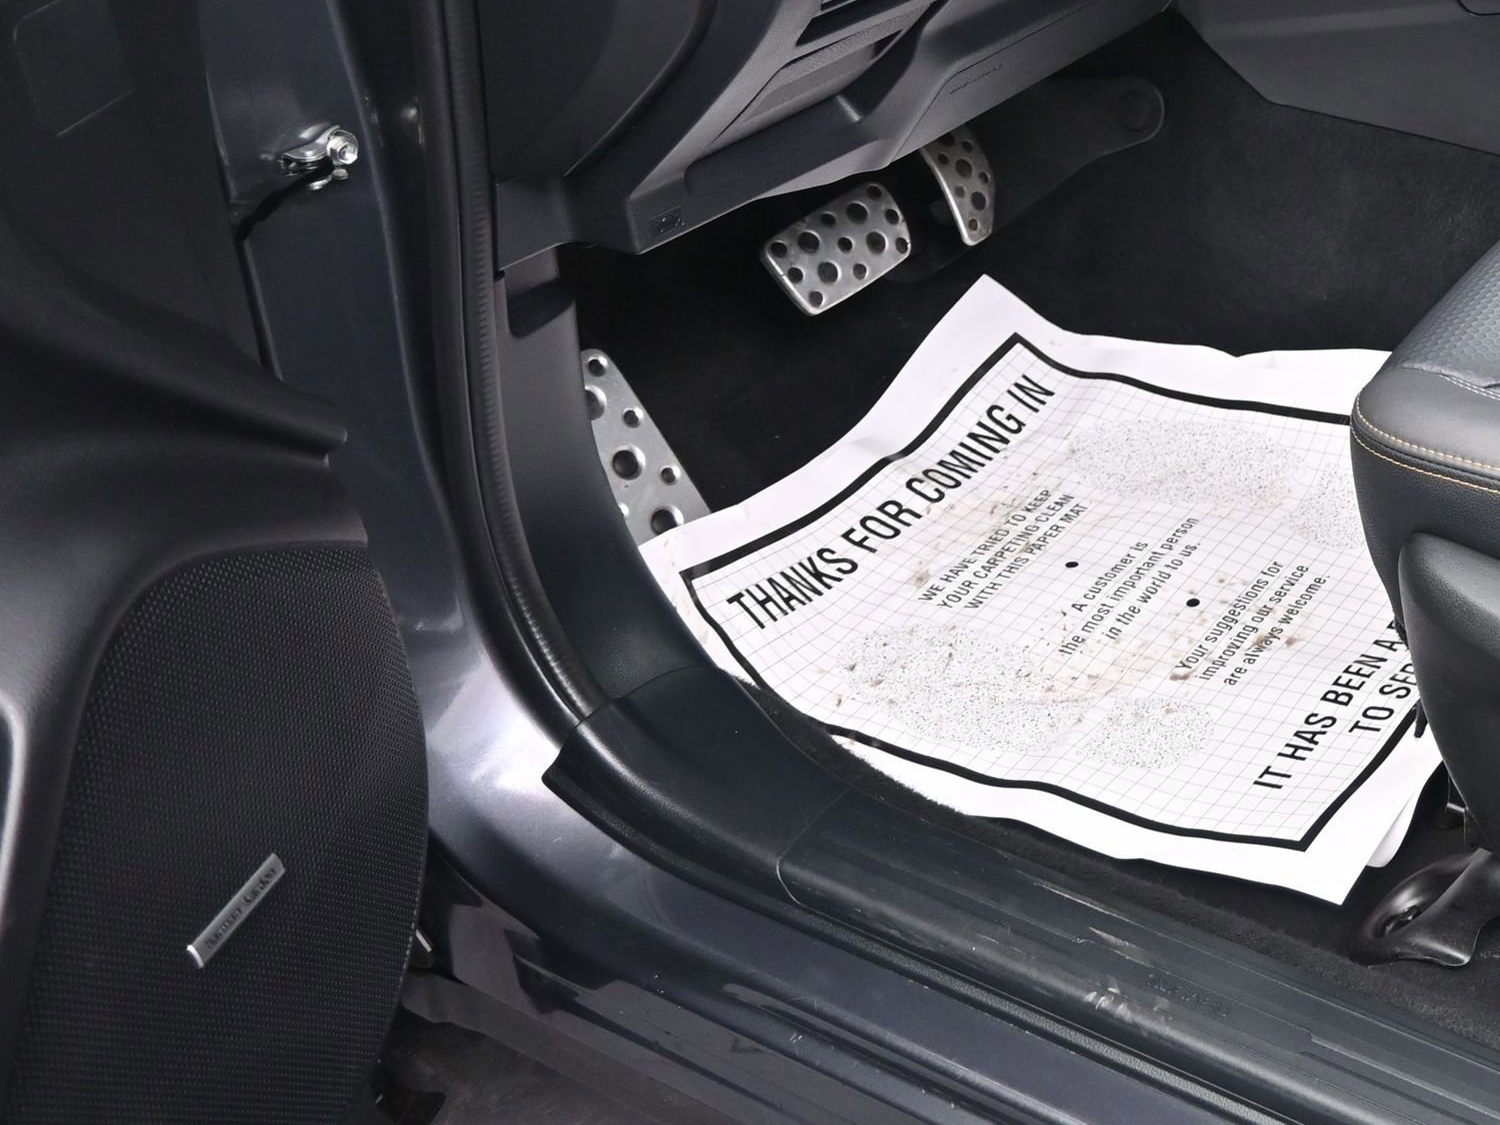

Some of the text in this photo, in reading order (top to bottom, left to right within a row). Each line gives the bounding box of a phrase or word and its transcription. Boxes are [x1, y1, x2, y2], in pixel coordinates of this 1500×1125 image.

[726, 374, 1055, 630] THANKS FOR COMING IN
[918, 489, 1051, 602] WE HAVE TRIED TO KEEP
[937, 494, 1075, 609] YOUR CARPETING CLEAN
[964, 503, 1088, 610] WITH THIS PAPER MAT
[1058, 517, 1199, 655] the most important person
[1071, 542, 1148, 612] A customer is
[1102, 626, 1123, 640] in
[1115, 605, 1141, 625] the
[1136, 570, 1172, 604] world
[1164, 558, 1184, 570] to
[1175, 561, 1284, 671] Your suggestions for
[1195, 565, 1309, 681] improving our service
[1223, 575, 1331, 686] are always welcome.
[1253, 639, 1403, 789] IT HAS BEEN A
[1348, 705, 1395, 733] TO
